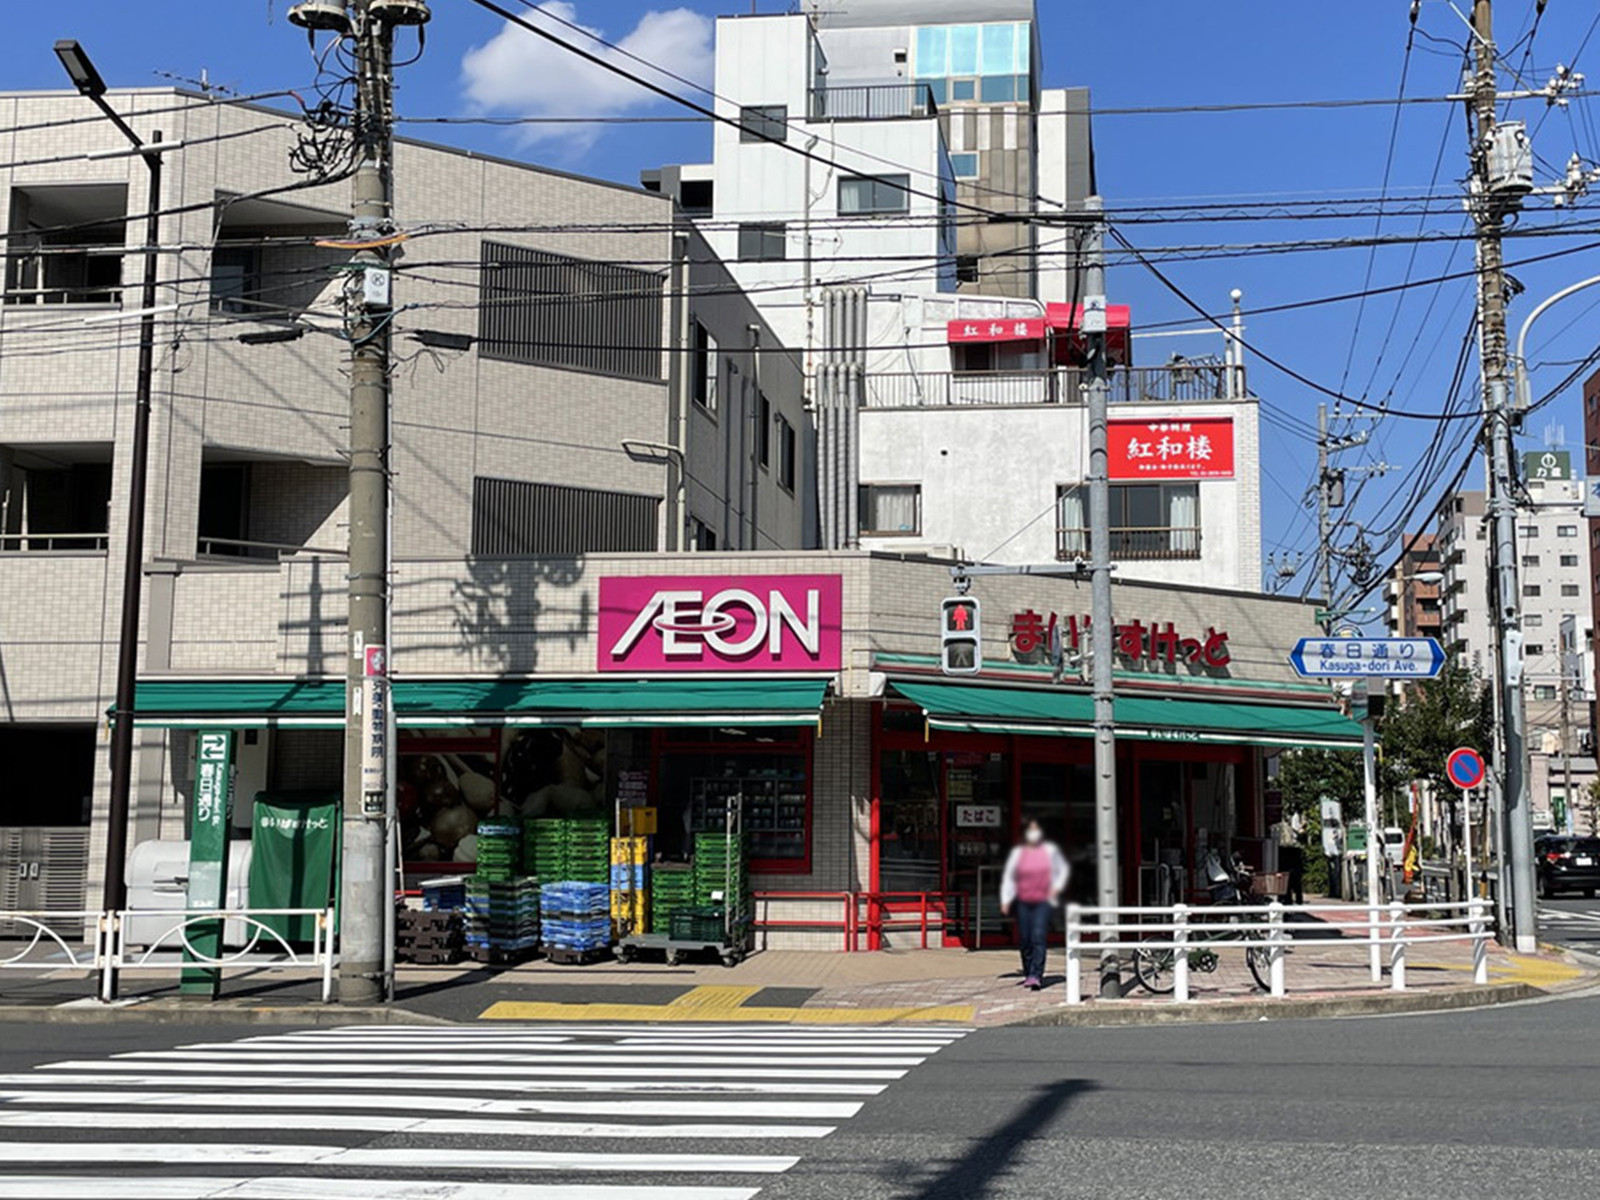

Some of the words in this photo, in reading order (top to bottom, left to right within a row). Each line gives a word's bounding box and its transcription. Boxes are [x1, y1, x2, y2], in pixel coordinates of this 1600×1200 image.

[963, 322, 1028, 337] 紅和楼
[1127, 435, 1212, 461] 紅和楼
[1012, 609, 1231, 668] まいすけっと
[1319, 643, 1415, 660] 春日通り
[1319, 660, 1390, 673] Kasuga-dori
[1394, 661, 1418, 672] Ave.
[197, 763, 215, 822] 春日通り
[962, 809, 996, 823] たばこ
